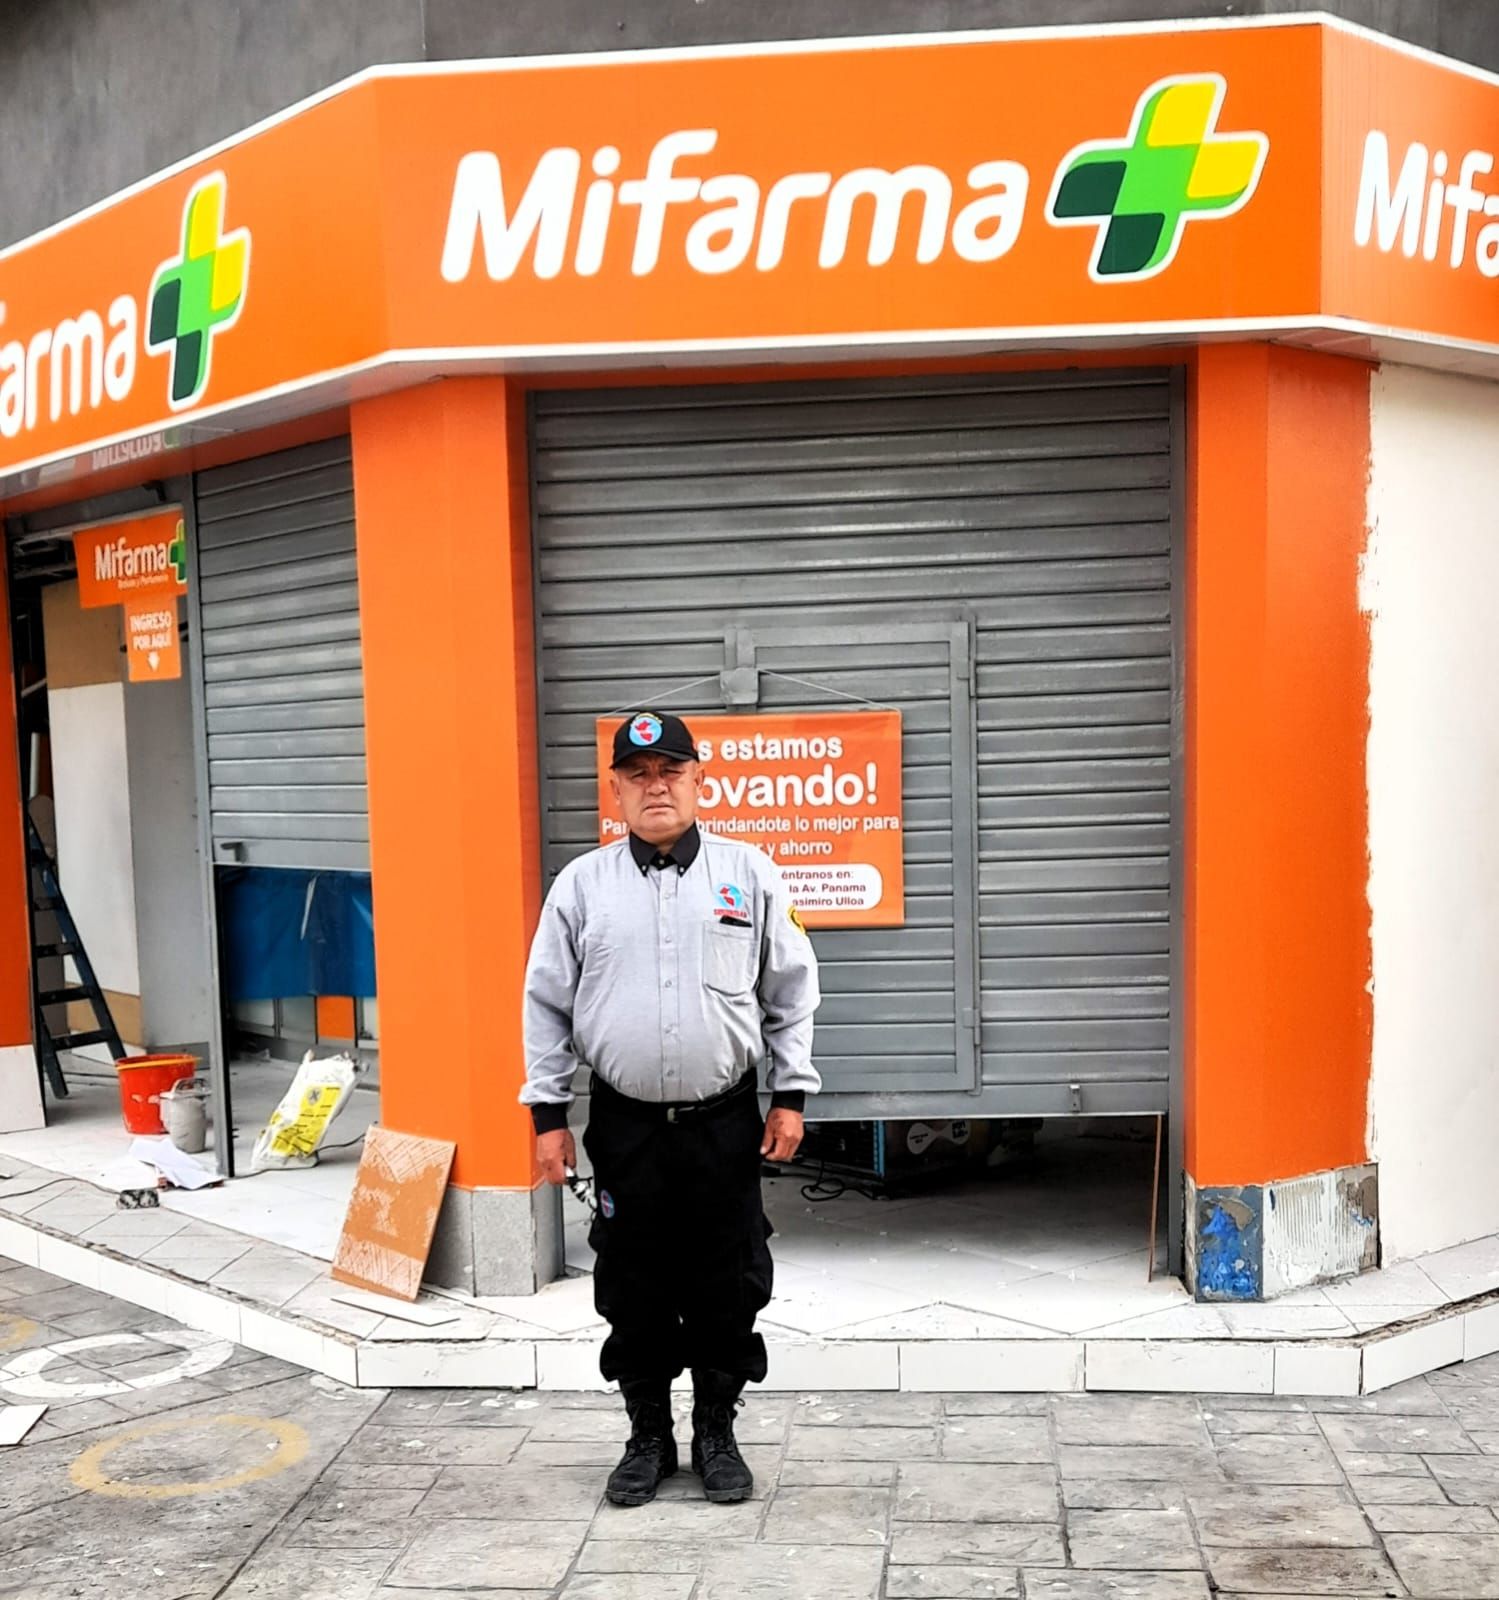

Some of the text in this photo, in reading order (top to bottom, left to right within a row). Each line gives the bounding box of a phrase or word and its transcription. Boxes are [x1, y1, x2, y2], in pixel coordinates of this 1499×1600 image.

[440, 129, 1029, 284] Mifarma
[0, 294, 138, 438] arma
[95, 537, 167, 580] Mifarma
[129, 611, 172, 632] INGRESO
[133, 635, 150, 650] POR
[697, 732, 843, 763] s estamos
[697, 762, 878, 810] ovando!
[602, 815, 900, 836] Par brindandote lo mejor para
[766, 842, 777, 859] y
[779, 839, 832, 856] ahorro
[781, 869, 833, 880] éntranos
[789, 884, 799, 893] la
[821, 883, 866, 893] Panama
[792, 896, 864, 906] asimiro Ulloa
